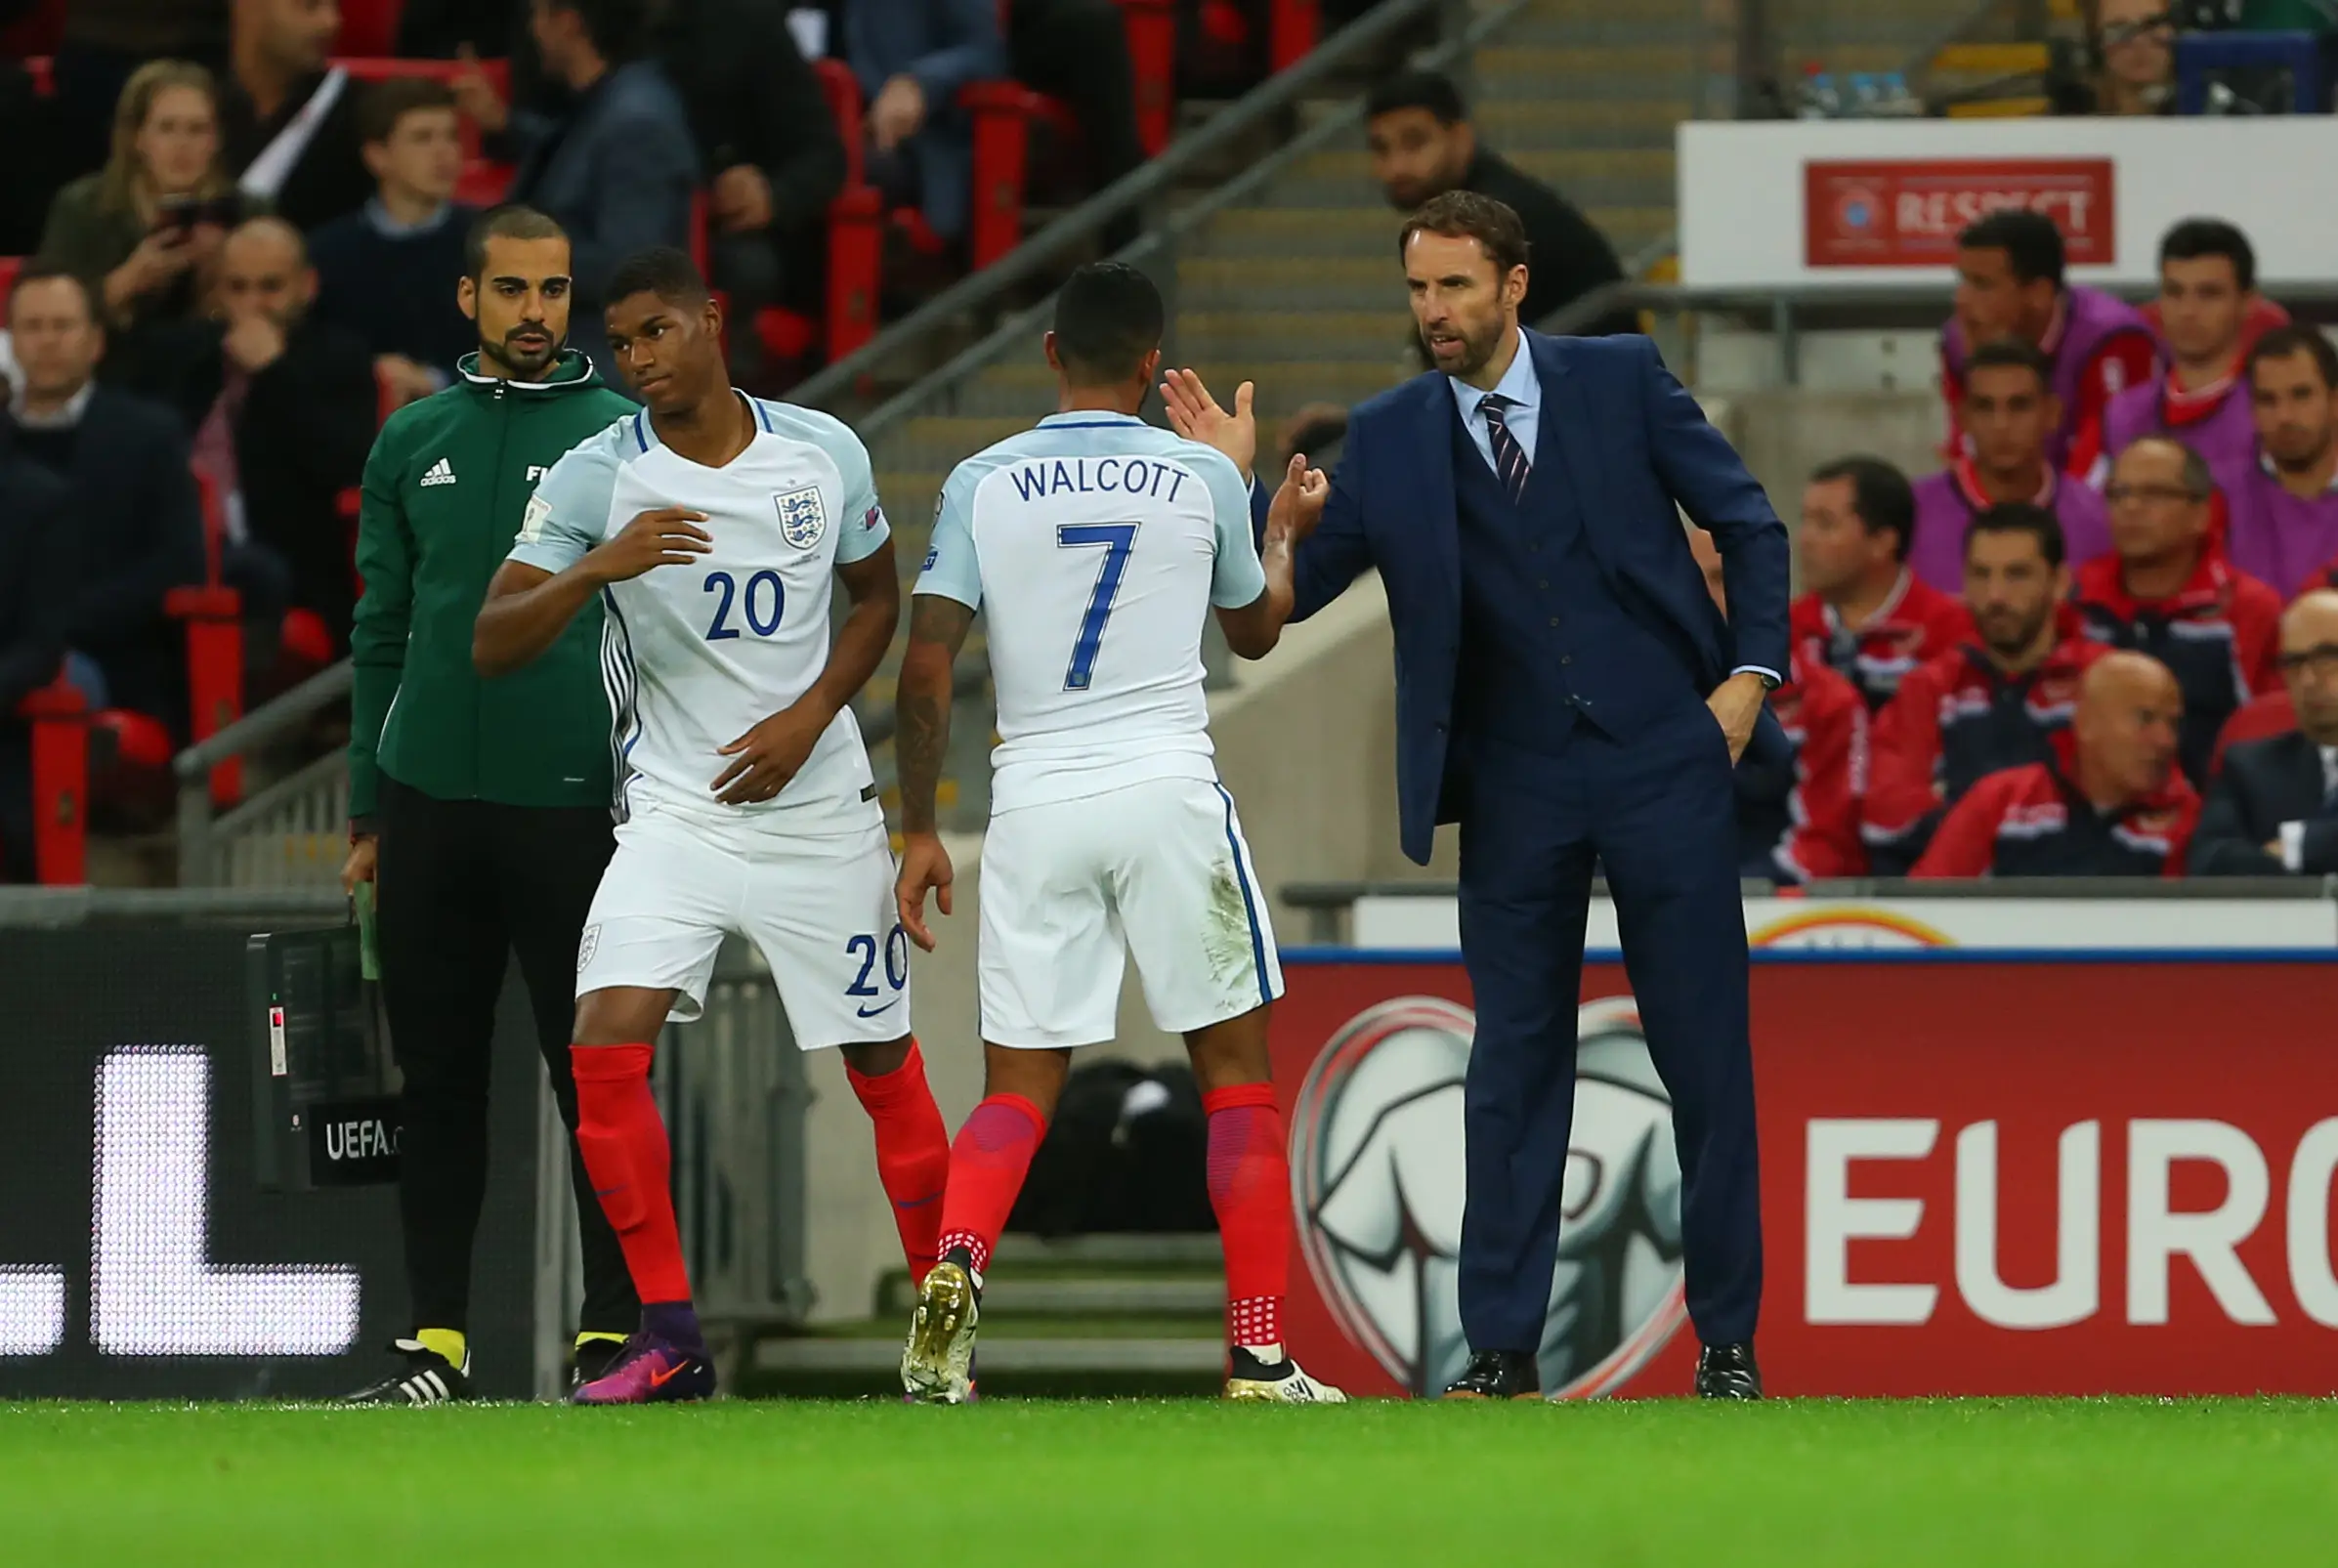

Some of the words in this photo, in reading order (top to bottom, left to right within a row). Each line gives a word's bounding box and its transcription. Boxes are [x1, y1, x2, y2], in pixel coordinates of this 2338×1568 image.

[1010, 458, 1189, 502] WALCOTT
[703, 570, 785, 640] 20
[1056, 521, 1142, 691] 7
[844, 923, 908, 996] 20
